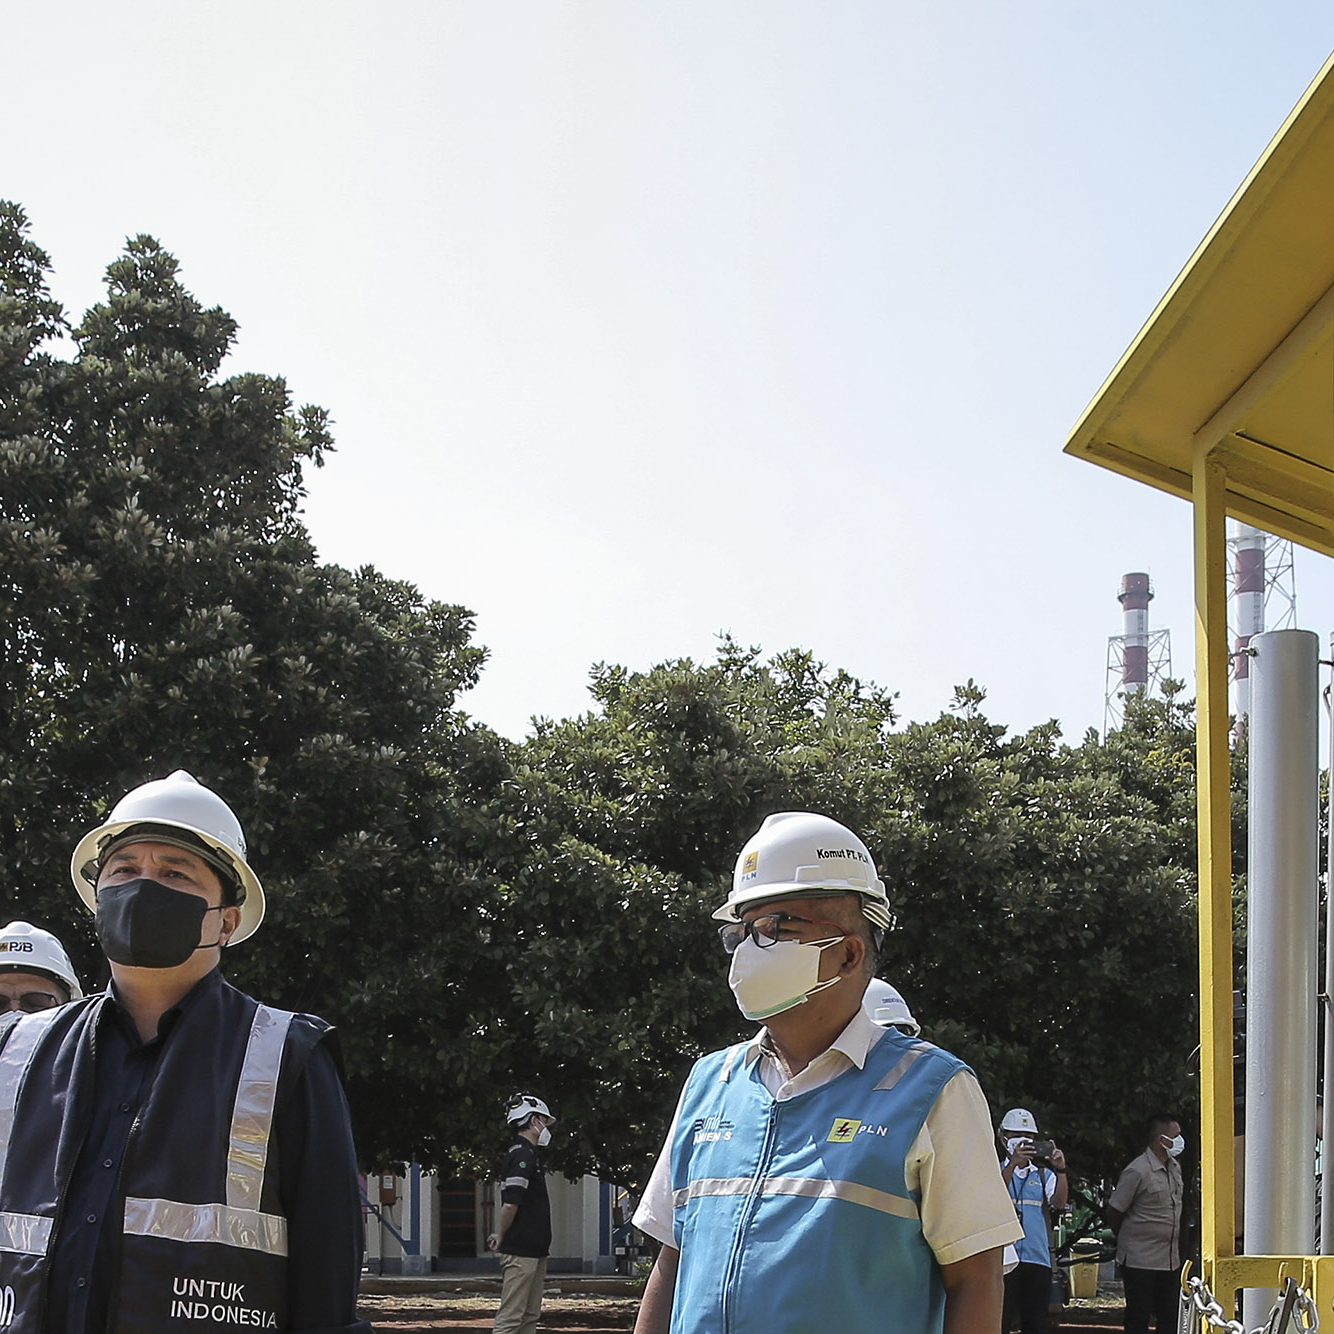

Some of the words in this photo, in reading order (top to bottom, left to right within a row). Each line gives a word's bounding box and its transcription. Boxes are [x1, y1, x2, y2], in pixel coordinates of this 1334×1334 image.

[817, 849, 845, 860] Komut
[742, 872, 757, 881] PLN
[9, 941, 34, 953] PJB
[858, 1124, 888, 1137] PLN
[172, 1277, 245, 1303] UNTUK
[170, 1300, 278, 1329] INDONESIA
